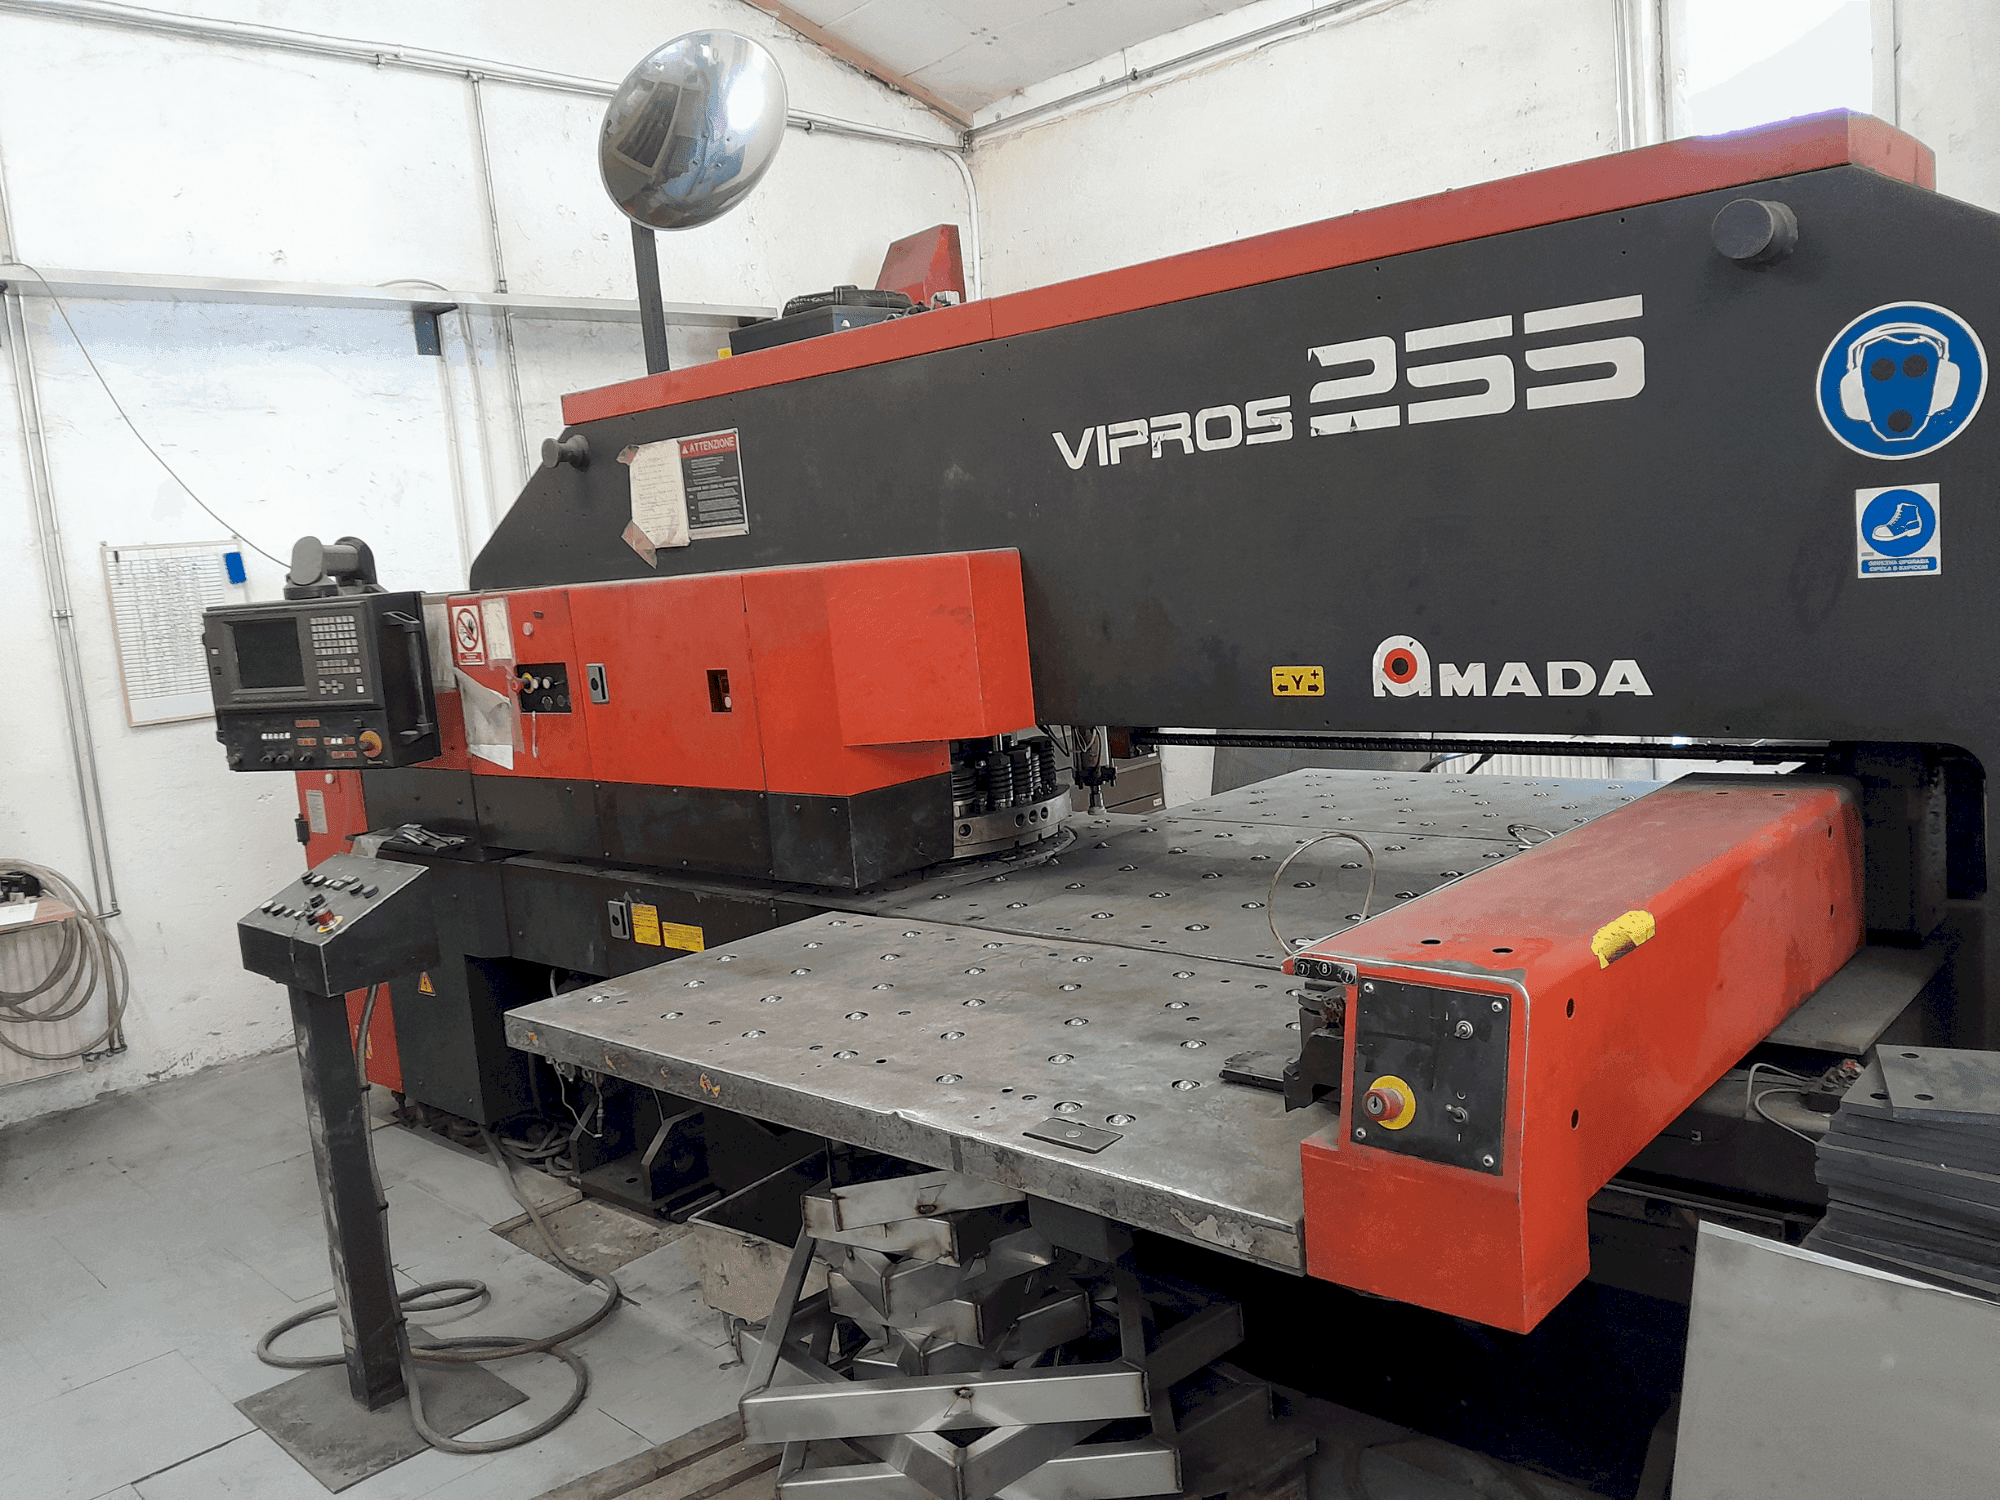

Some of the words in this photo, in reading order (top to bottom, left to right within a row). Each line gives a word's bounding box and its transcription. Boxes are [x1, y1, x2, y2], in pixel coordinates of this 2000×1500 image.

[1052, 395, 1293, 470] VIPROS
[1307, 294, 1646, 438] 255
[689, 436, 735, 453] ATTENZIONE
[1291, 674, 1304, 690] Y
[1372, 634, 1654, 698] AMADA
